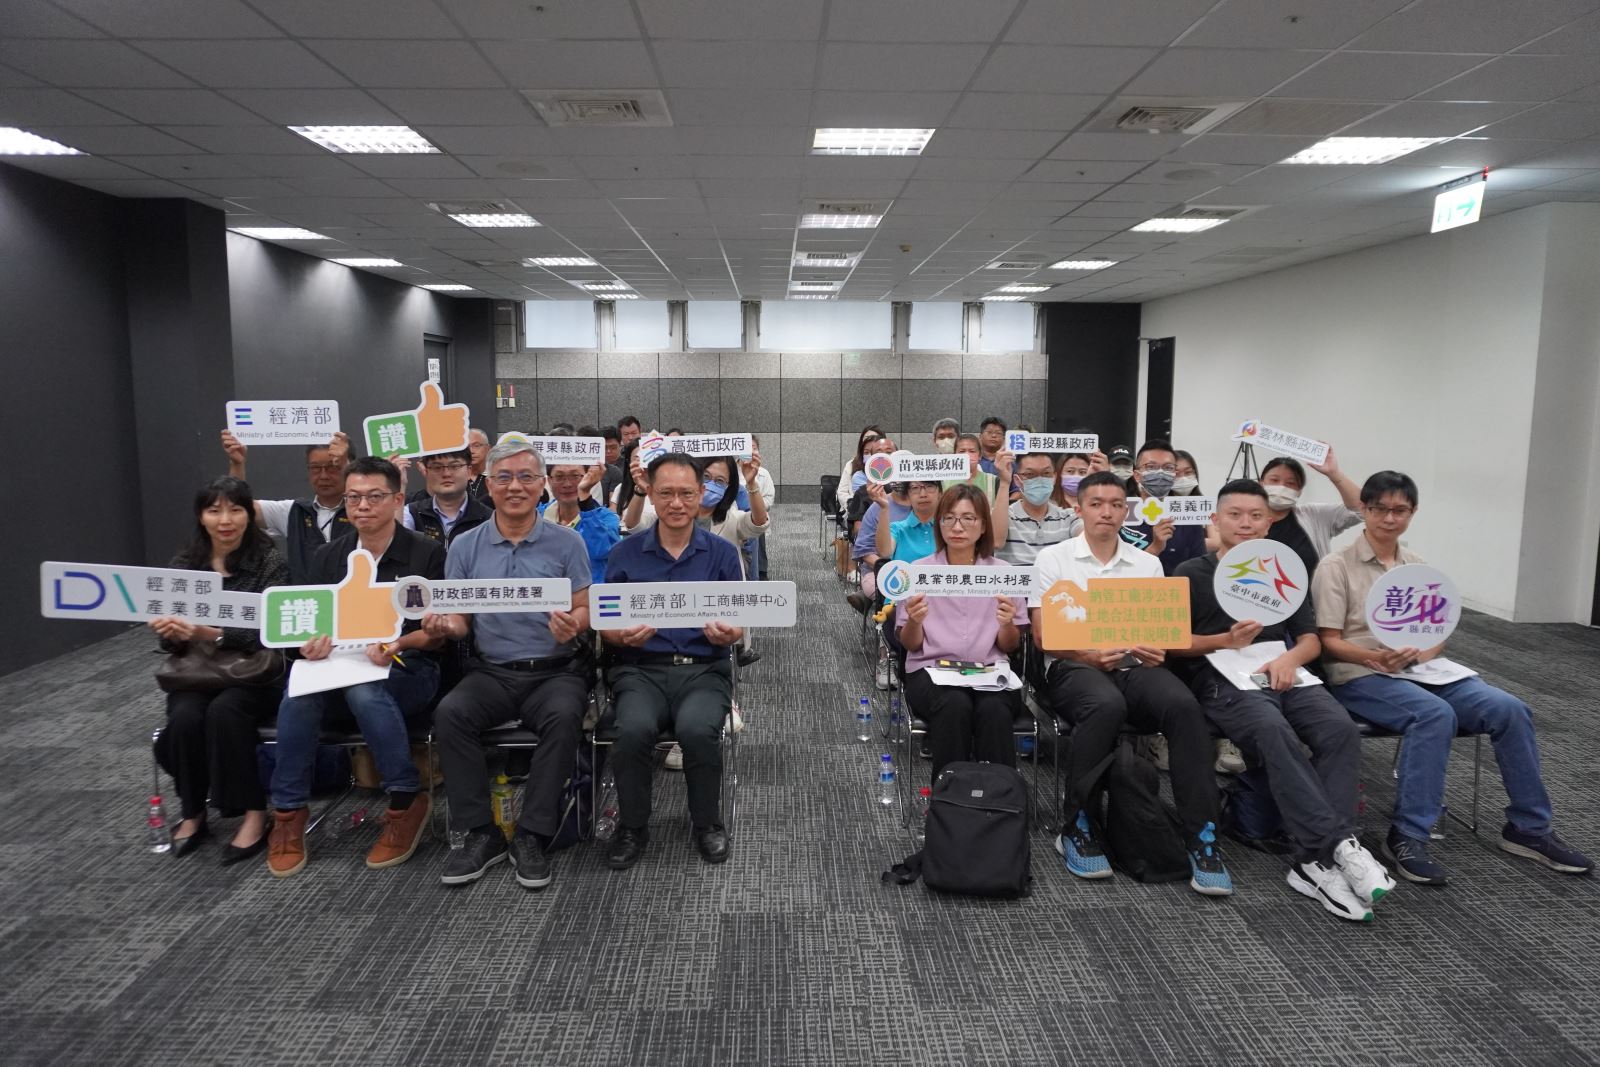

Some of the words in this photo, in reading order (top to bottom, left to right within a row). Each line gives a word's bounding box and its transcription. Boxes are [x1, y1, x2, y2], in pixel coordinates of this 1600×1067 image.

[269, 406, 332, 425] 經濟部
[236, 431, 264, 439] Ministry
[310, 430, 332, 438] Affairs
[378, 422, 408, 453] 讚
[532, 440, 601, 455] 屏東縣政府
[671, 437, 746, 453] 高雄市政府
[1029, 436, 1096, 450] 南投縣政府
[899, 457, 964, 471] 苗栗縣政府
[1169, 499, 1212, 513] 嘉義市
[145, 575, 212, 595] 經濟部
[915, 573, 1032, 586] 農業部農田水利署
[432, 586, 543, 600] 財政部國有財產署
[630, 593, 686, 609] 經濟部
[703, 593, 788, 608] 工商輔導中心
[1384, 583, 1447, 624] 彰化
[145, 599, 257, 621] 產業發展署
[279, 597, 319, 636] 讚
[630, 612, 656, 620] Ministry
